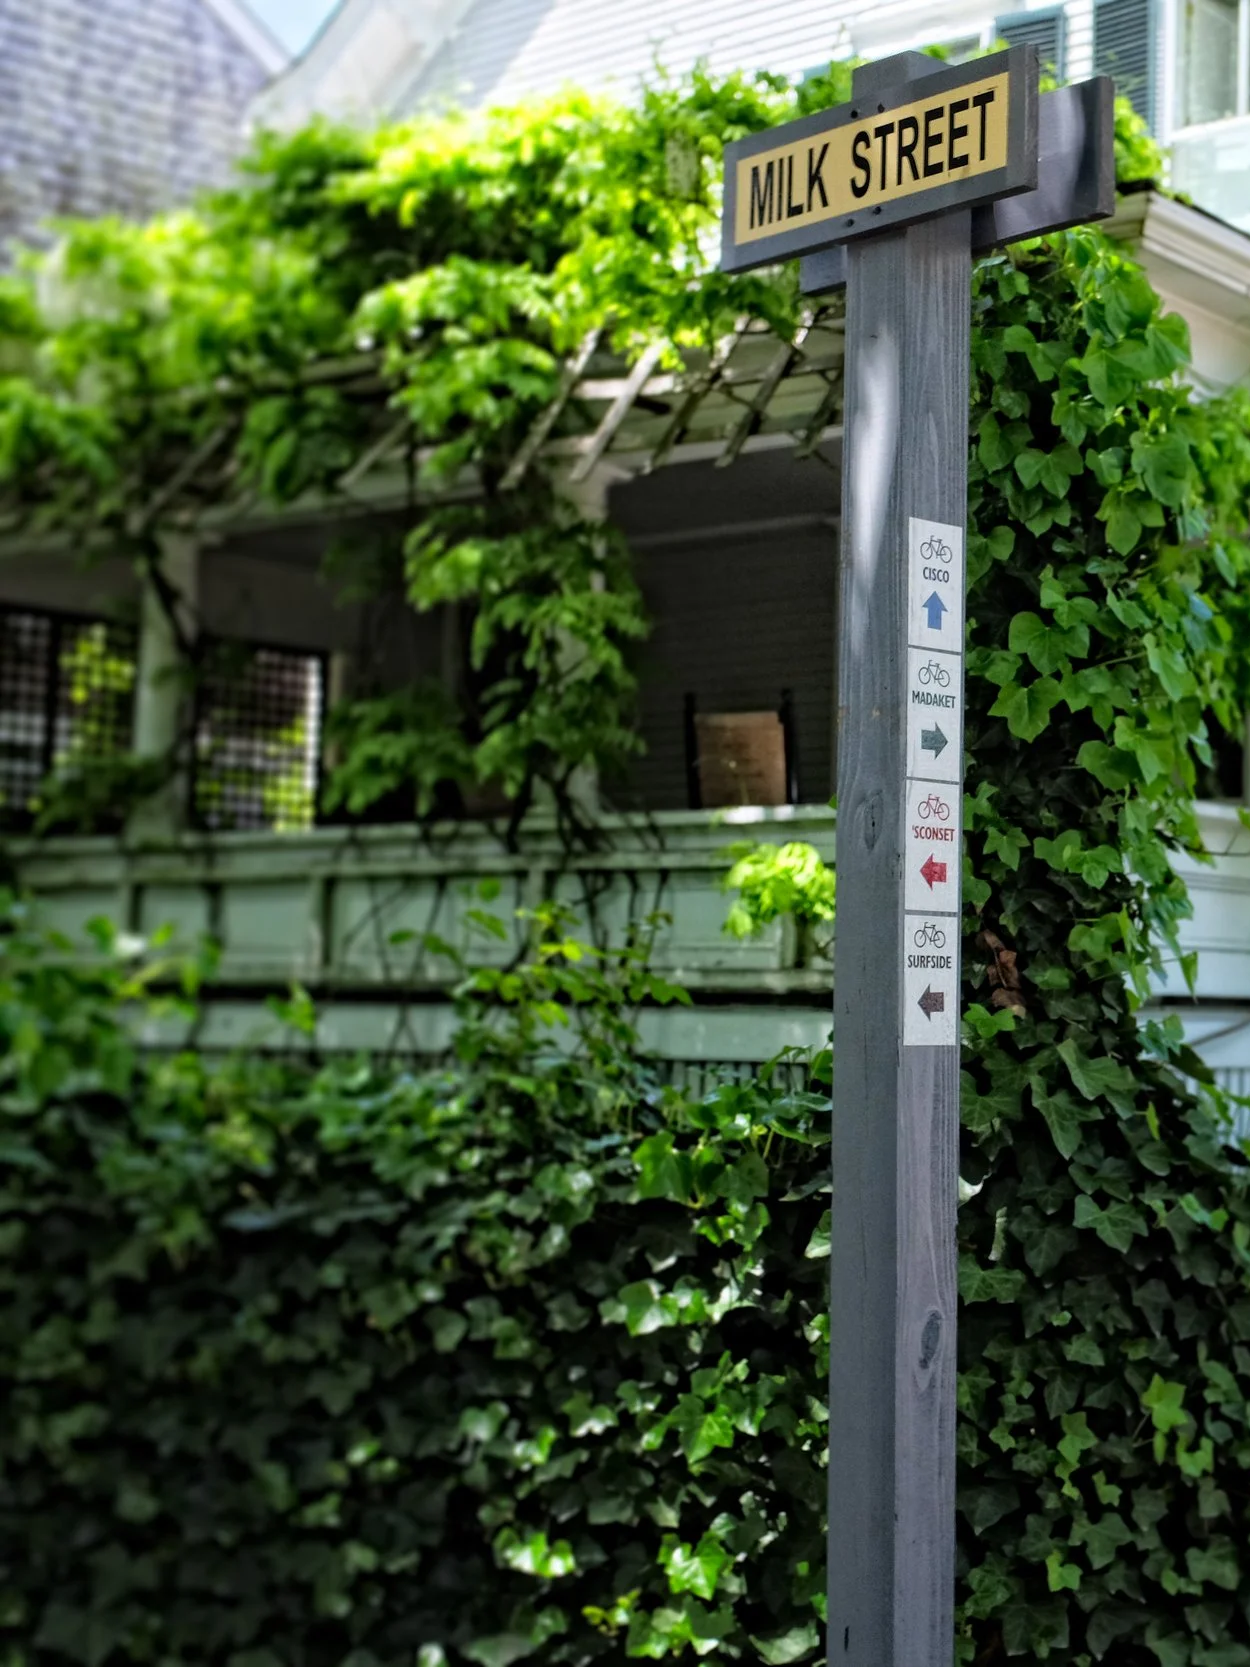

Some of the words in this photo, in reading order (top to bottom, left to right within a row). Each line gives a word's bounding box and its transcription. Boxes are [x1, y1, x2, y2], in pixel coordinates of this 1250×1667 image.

[750, 142, 830, 229] MILK
[850, 90, 995, 198] STREET
[922, 566, 950, 583] CISCO
[911, 690, 956, 709] MADAKET
[907, 954, 952, 969] SURFSIDE
